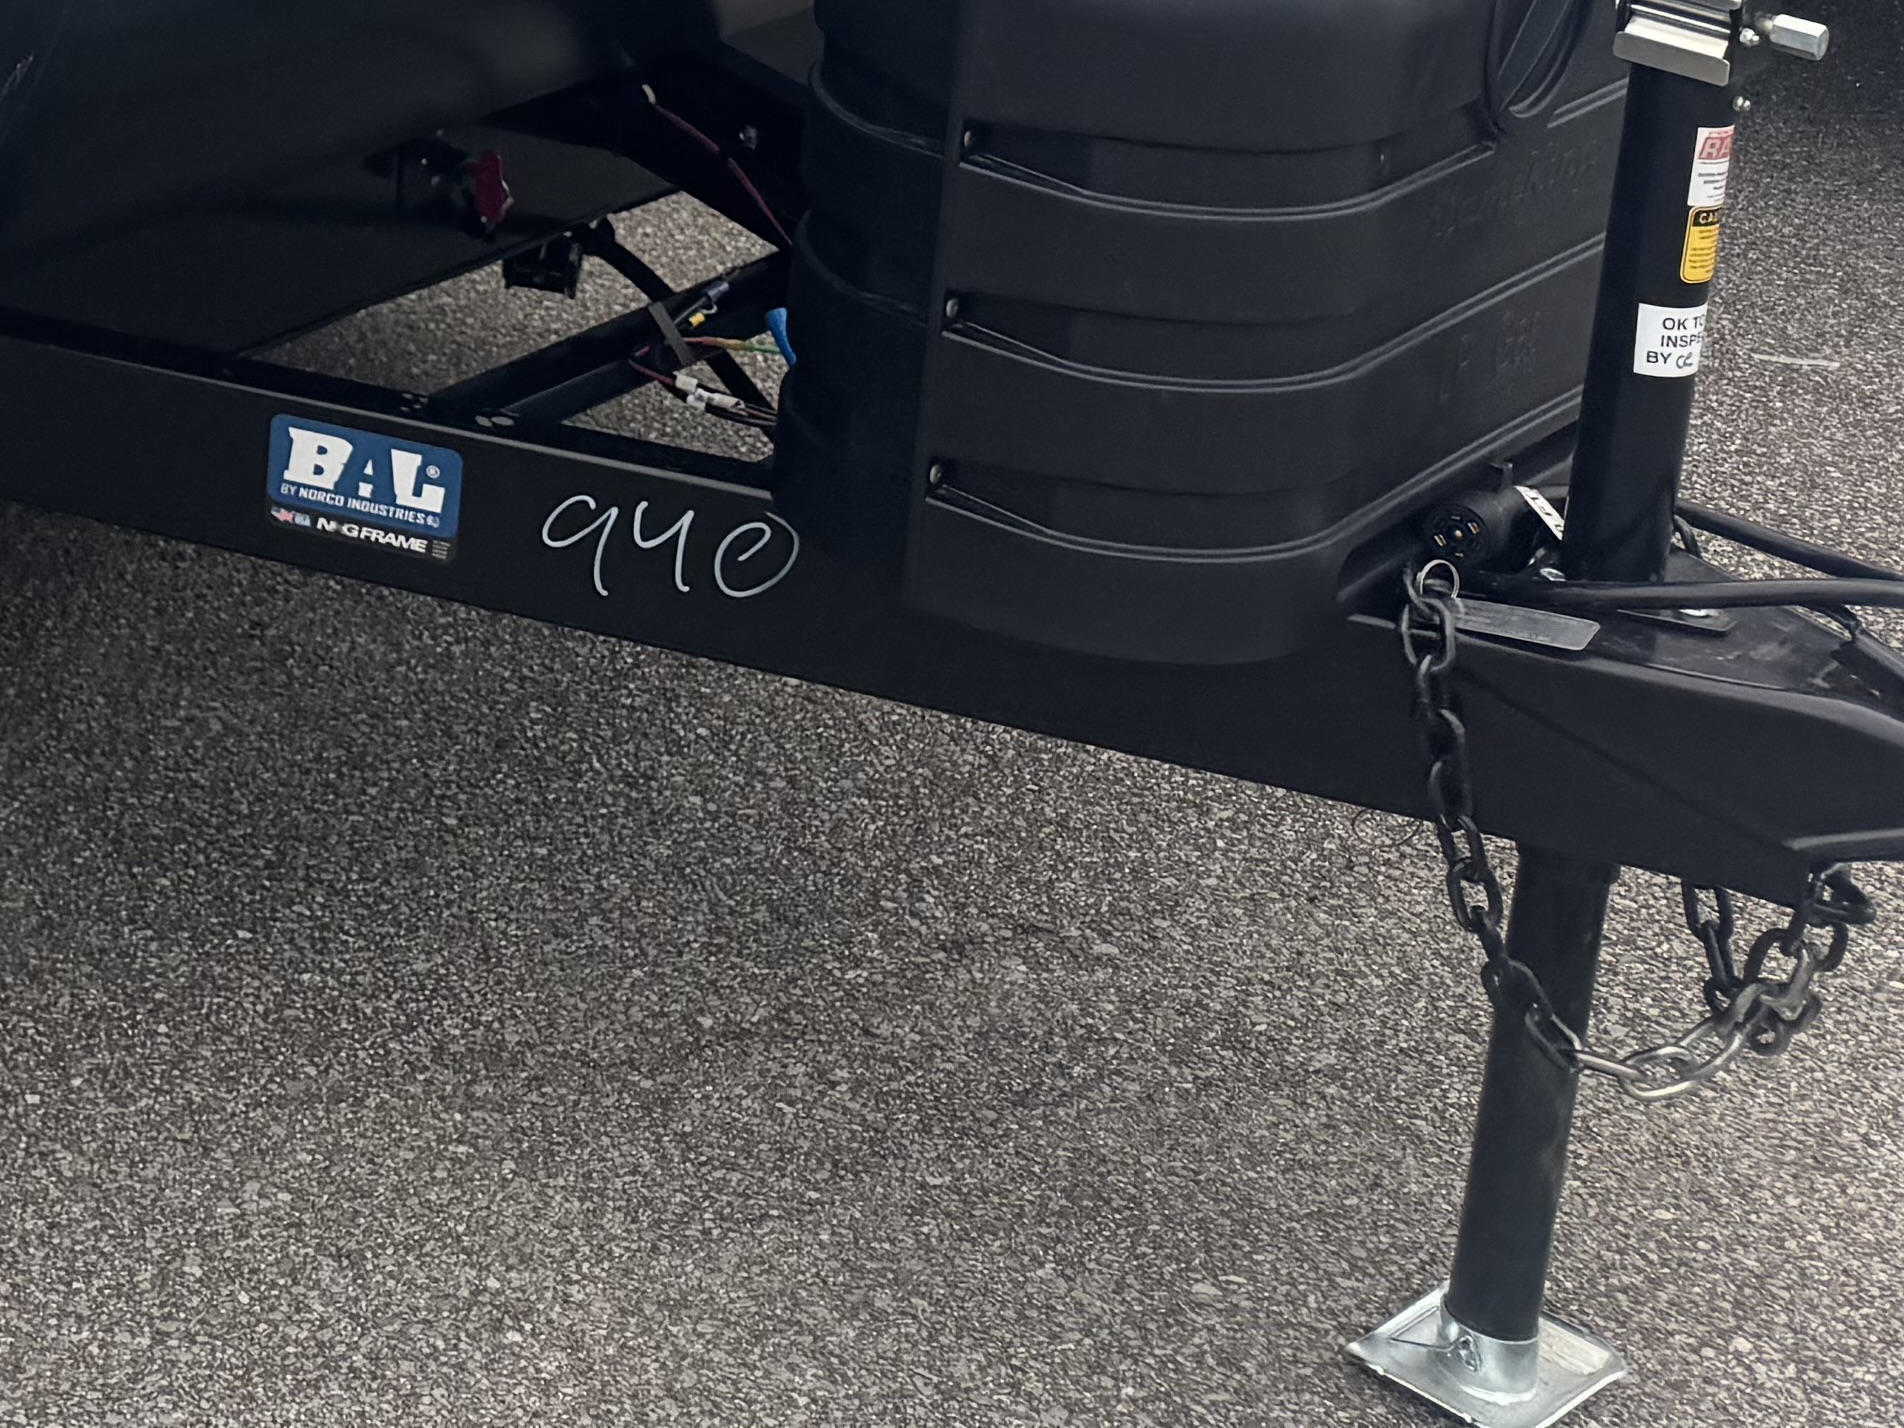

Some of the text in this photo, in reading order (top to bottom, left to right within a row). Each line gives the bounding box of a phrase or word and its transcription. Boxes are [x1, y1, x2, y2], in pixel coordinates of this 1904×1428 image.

[1662, 317, 1688, 331] OK
[1646, 350, 1672, 365] BY
[283, 426, 446, 514] BAL
[280, 483, 426, 525] BY NORCO INDUSTRIES
[360, 527, 428, 554] FRAME
